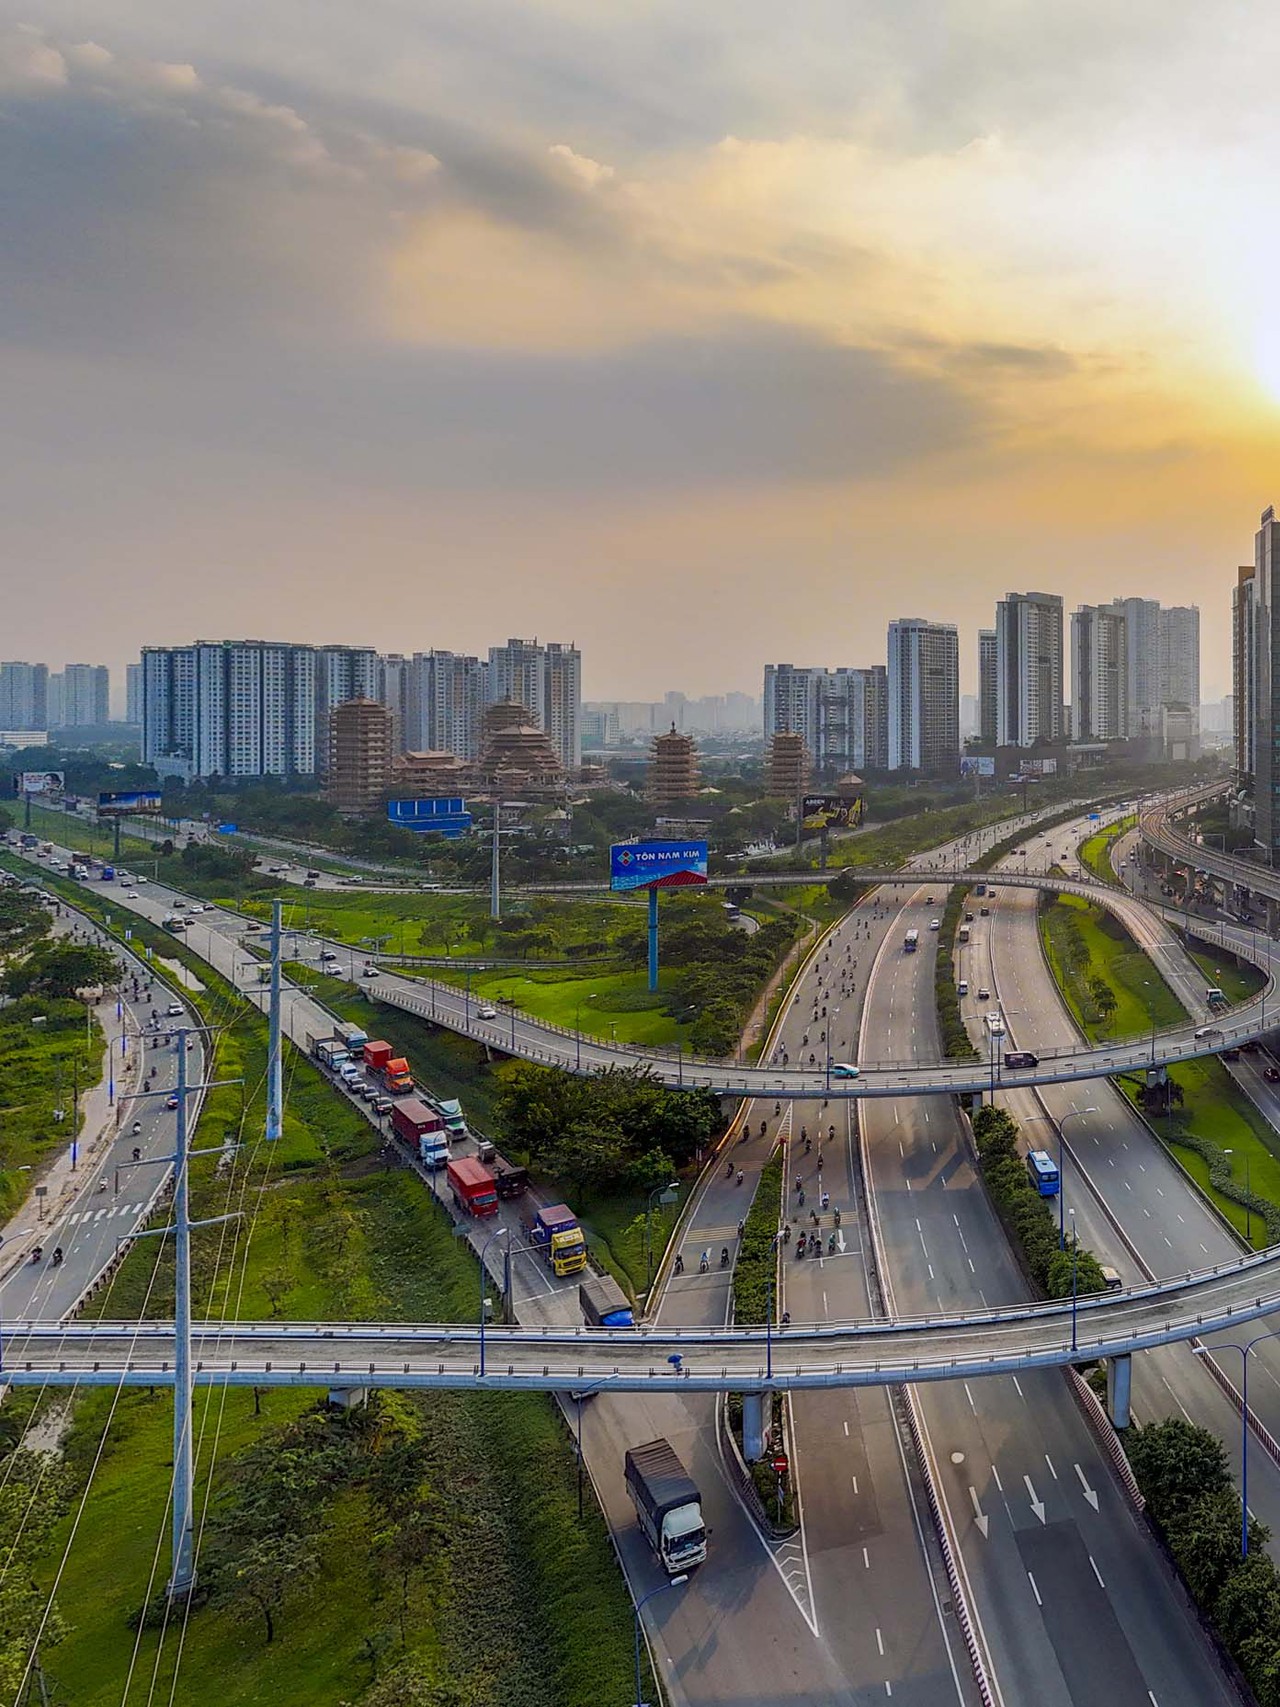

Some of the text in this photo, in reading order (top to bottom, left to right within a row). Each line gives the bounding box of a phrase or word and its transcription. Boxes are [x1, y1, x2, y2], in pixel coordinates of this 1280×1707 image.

[635, 850, 700, 861] TÔN NAM KIM
